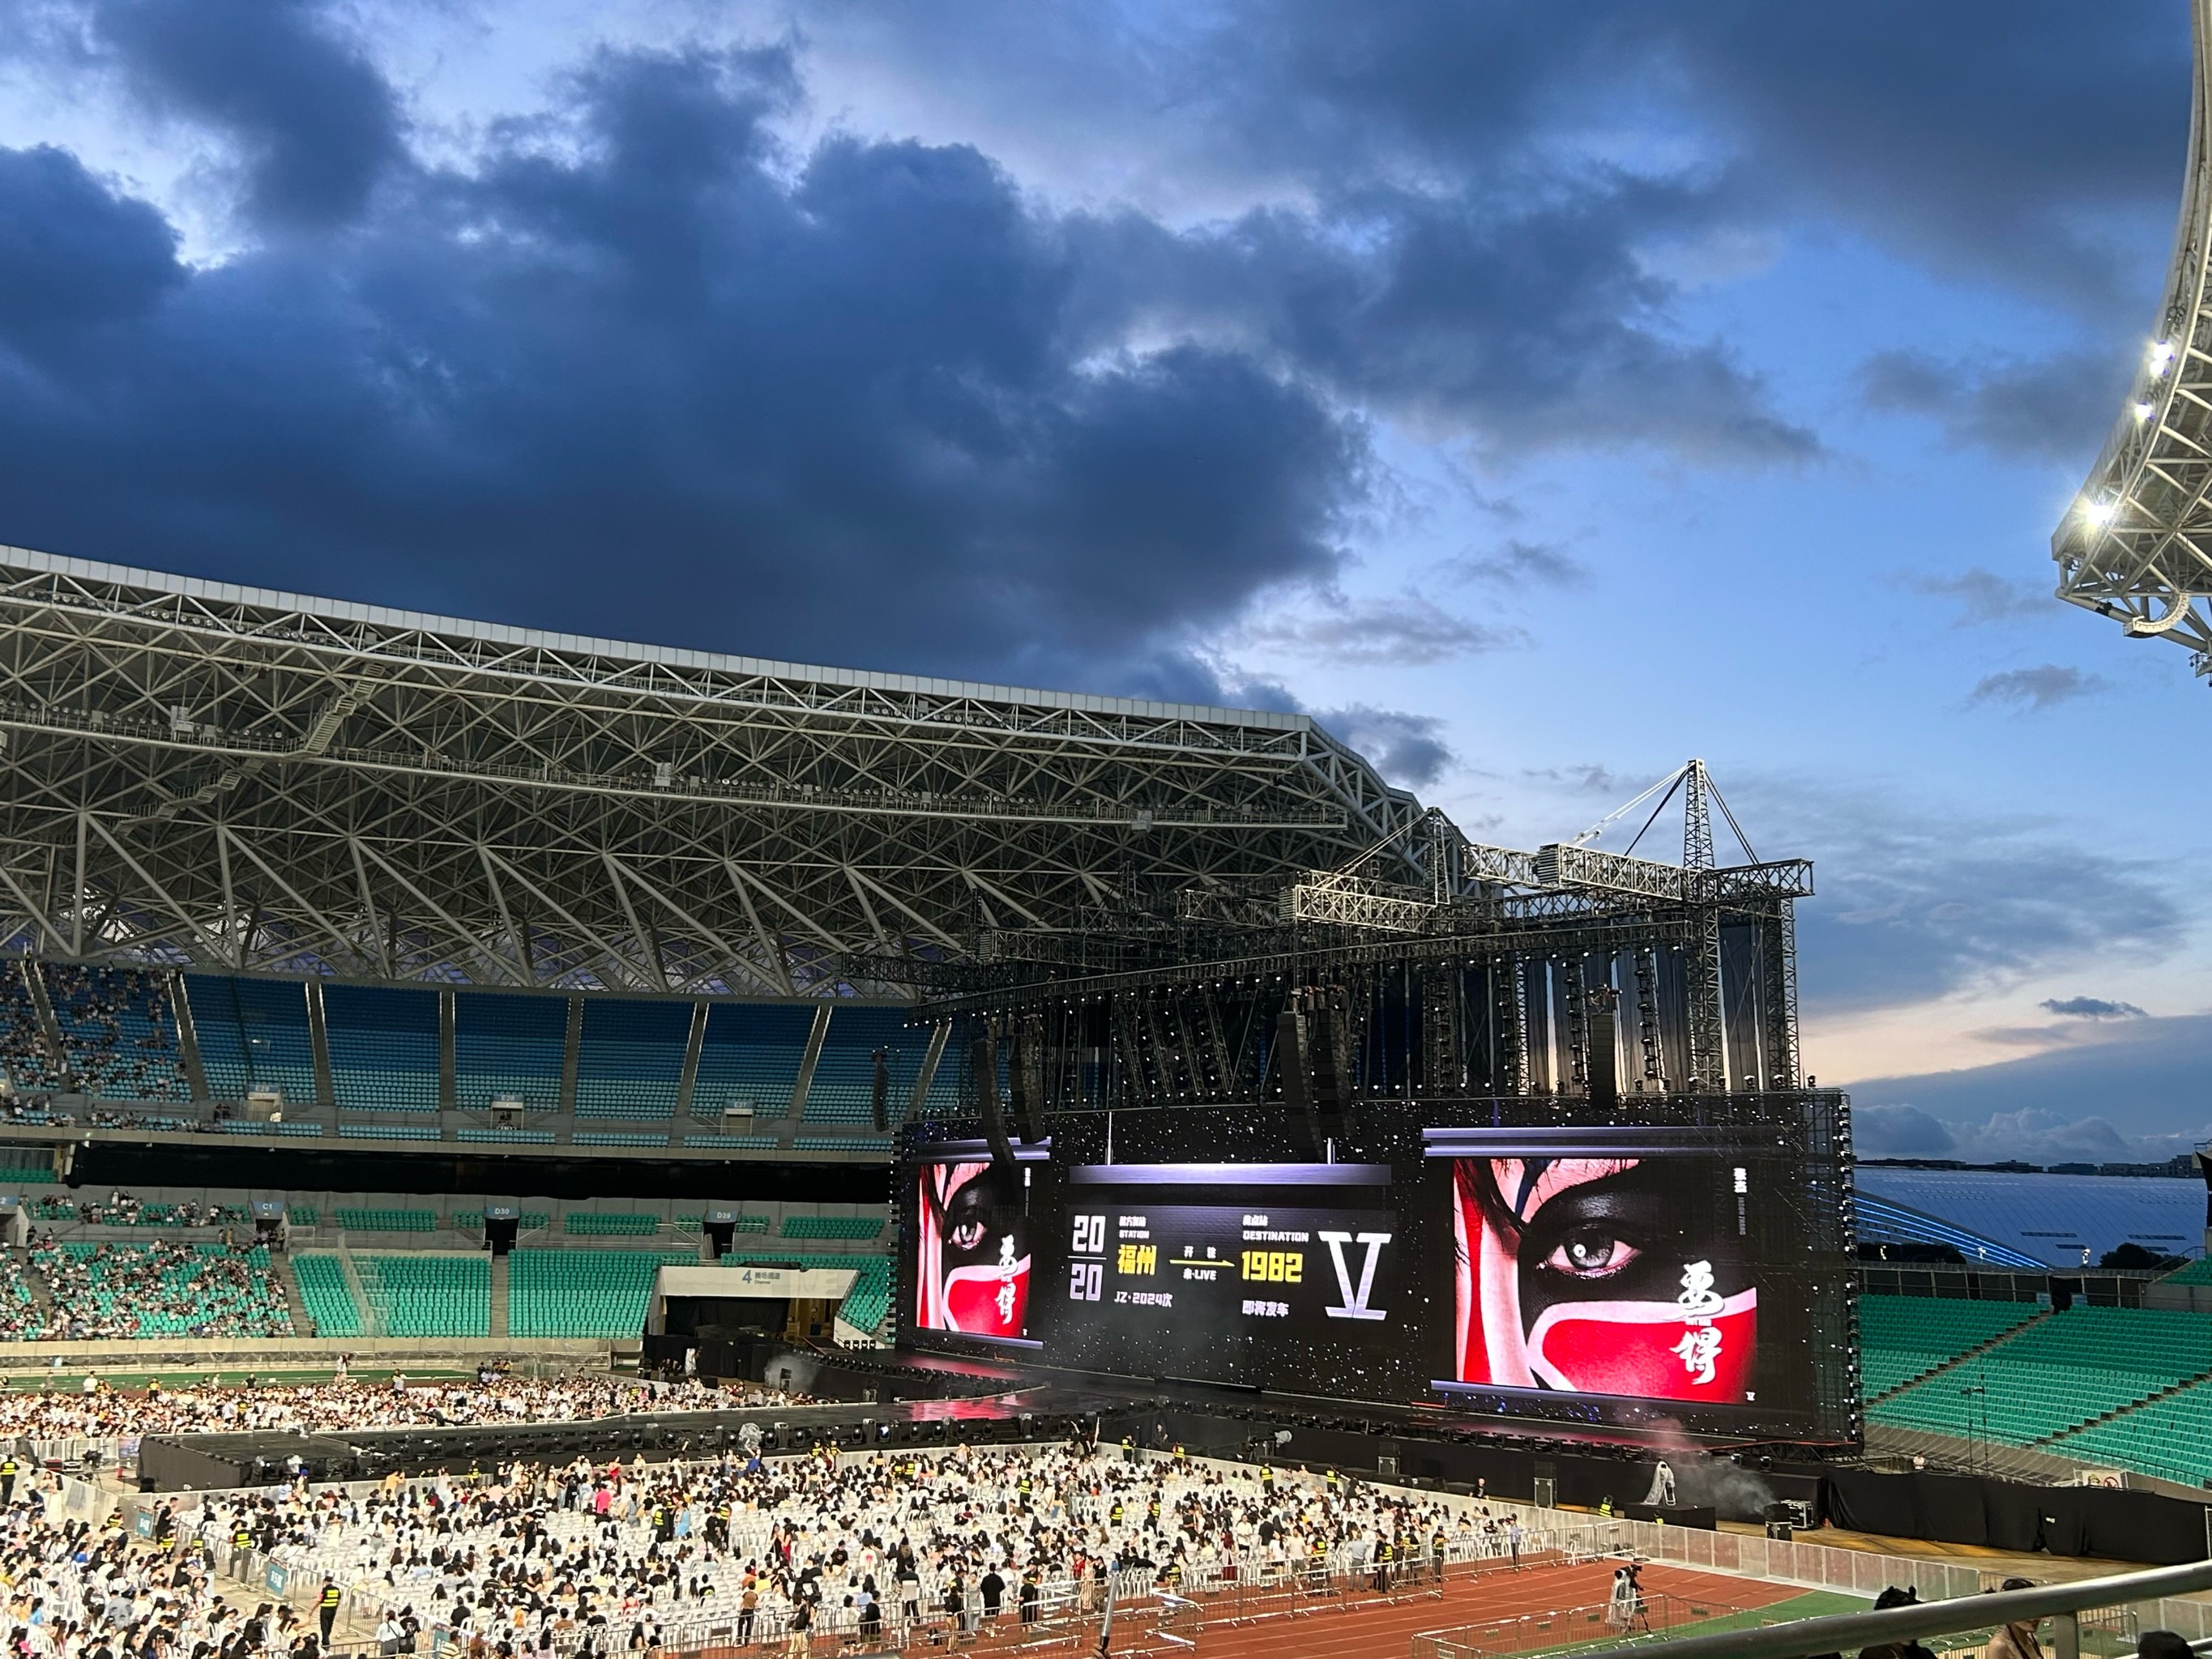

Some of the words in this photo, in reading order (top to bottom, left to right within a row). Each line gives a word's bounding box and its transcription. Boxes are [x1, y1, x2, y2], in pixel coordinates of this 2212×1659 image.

[494, 1207, 510, 1215] D30
[1072, 1215, 1106, 1252] 20
[1119, 1230, 1150, 1239] STATION
[1242, 1230, 1309, 1243] DESTINATION
[1117, 1243, 1157, 1276] 福州
[1241, 1251, 1304, 1283] 1982
[741, 1269, 752, 1284] 4
[1070, 1263, 1104, 1302] 20
[1317, 1230, 1393, 1321] V
[1241, 1299, 1290, 1318] 即将发车
